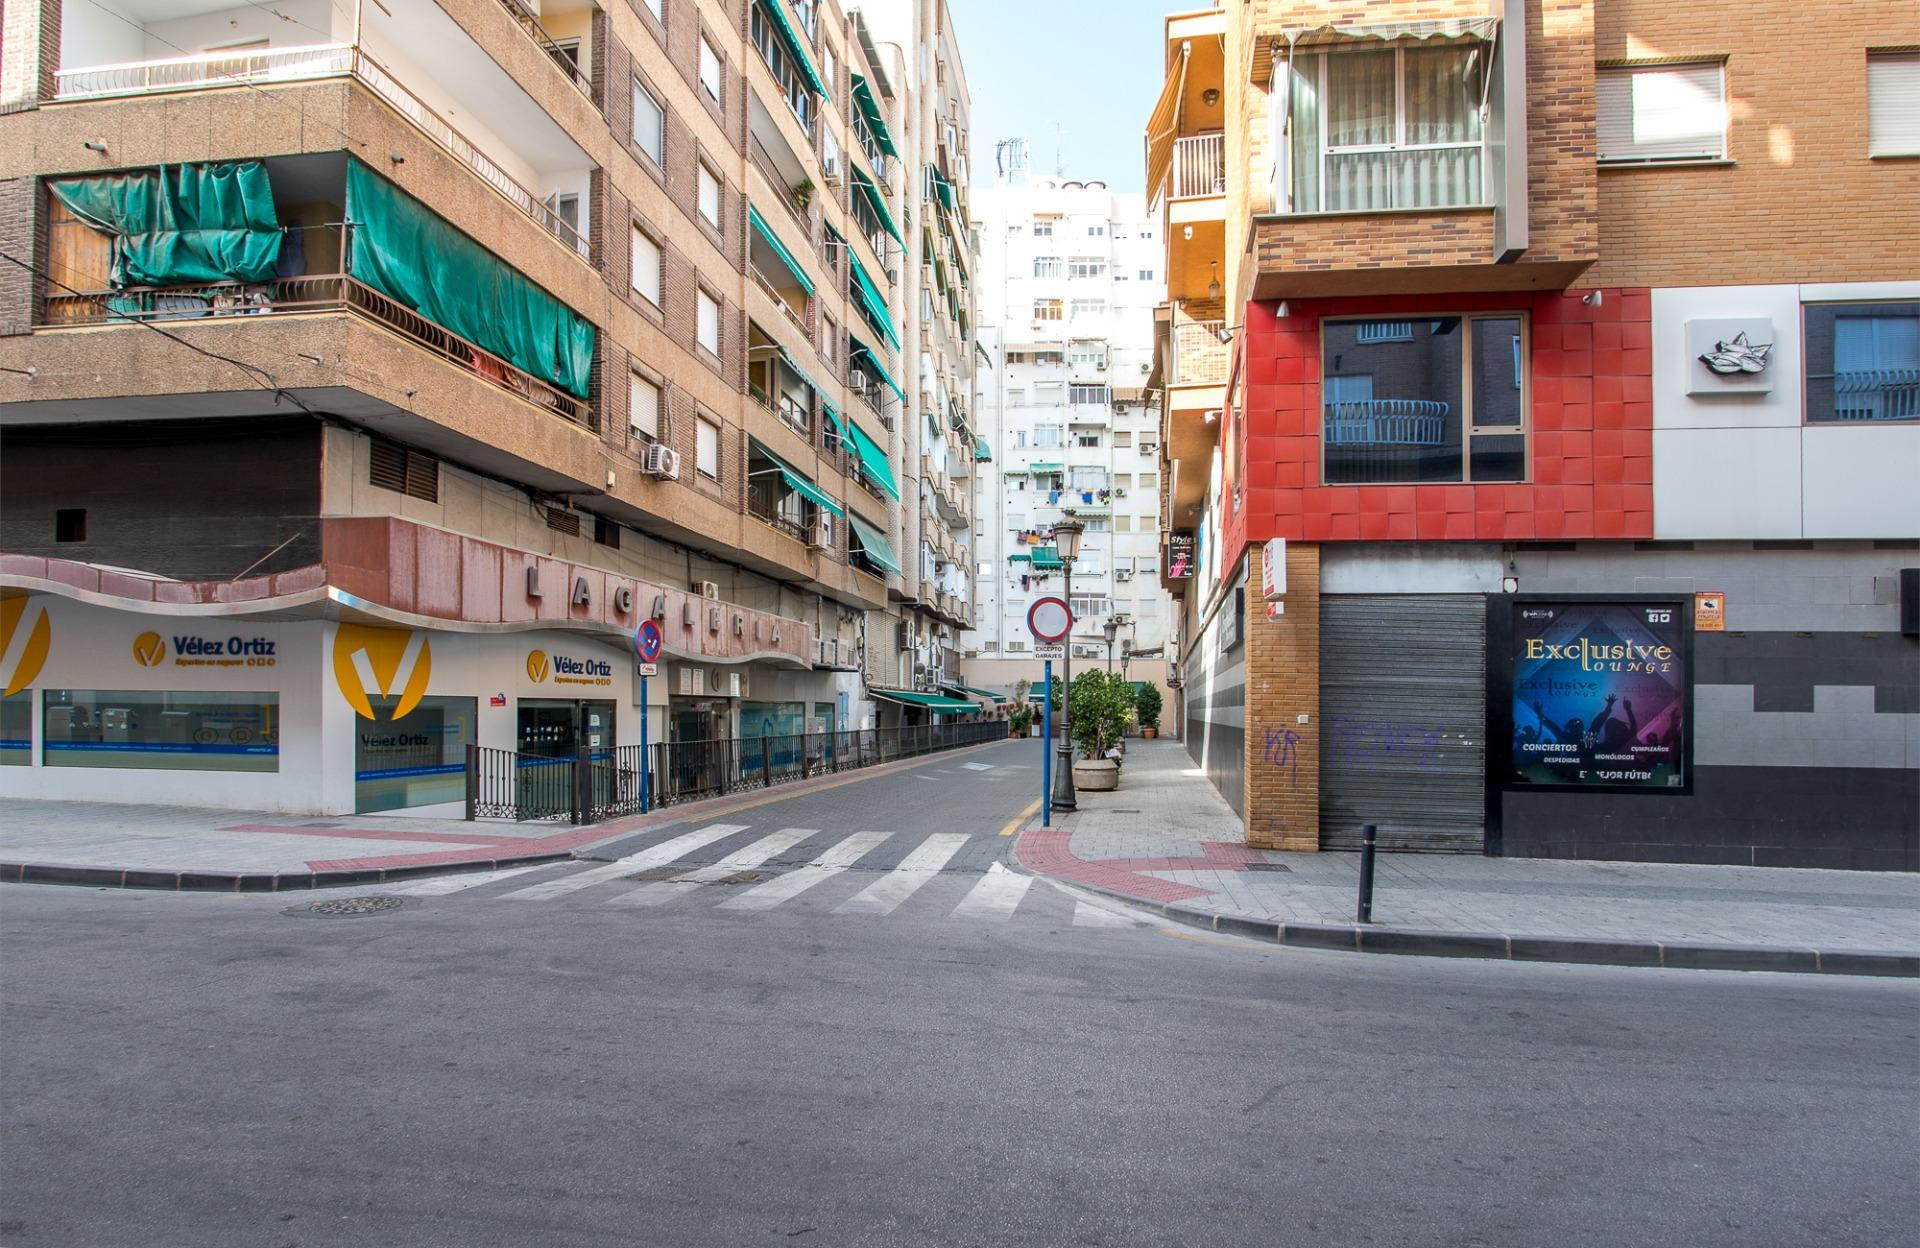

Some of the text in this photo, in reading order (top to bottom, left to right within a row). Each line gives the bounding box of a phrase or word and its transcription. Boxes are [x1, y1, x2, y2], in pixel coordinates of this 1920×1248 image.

[615, 586, 782, 643] GALERIA
[173, 636, 275, 655] Vélez Ortiz
[1525, 638, 1672, 672] Exclusive
[553, 655, 611, 676] Vélez Ortiz
[399, 734, 429, 746] Ortiz
[1523, 743, 1578, 752] CONCIERTOS
[1631, 745, 1670, 753] CUMPLEAÑOS
[1596, 770, 1623, 780] EJOR
